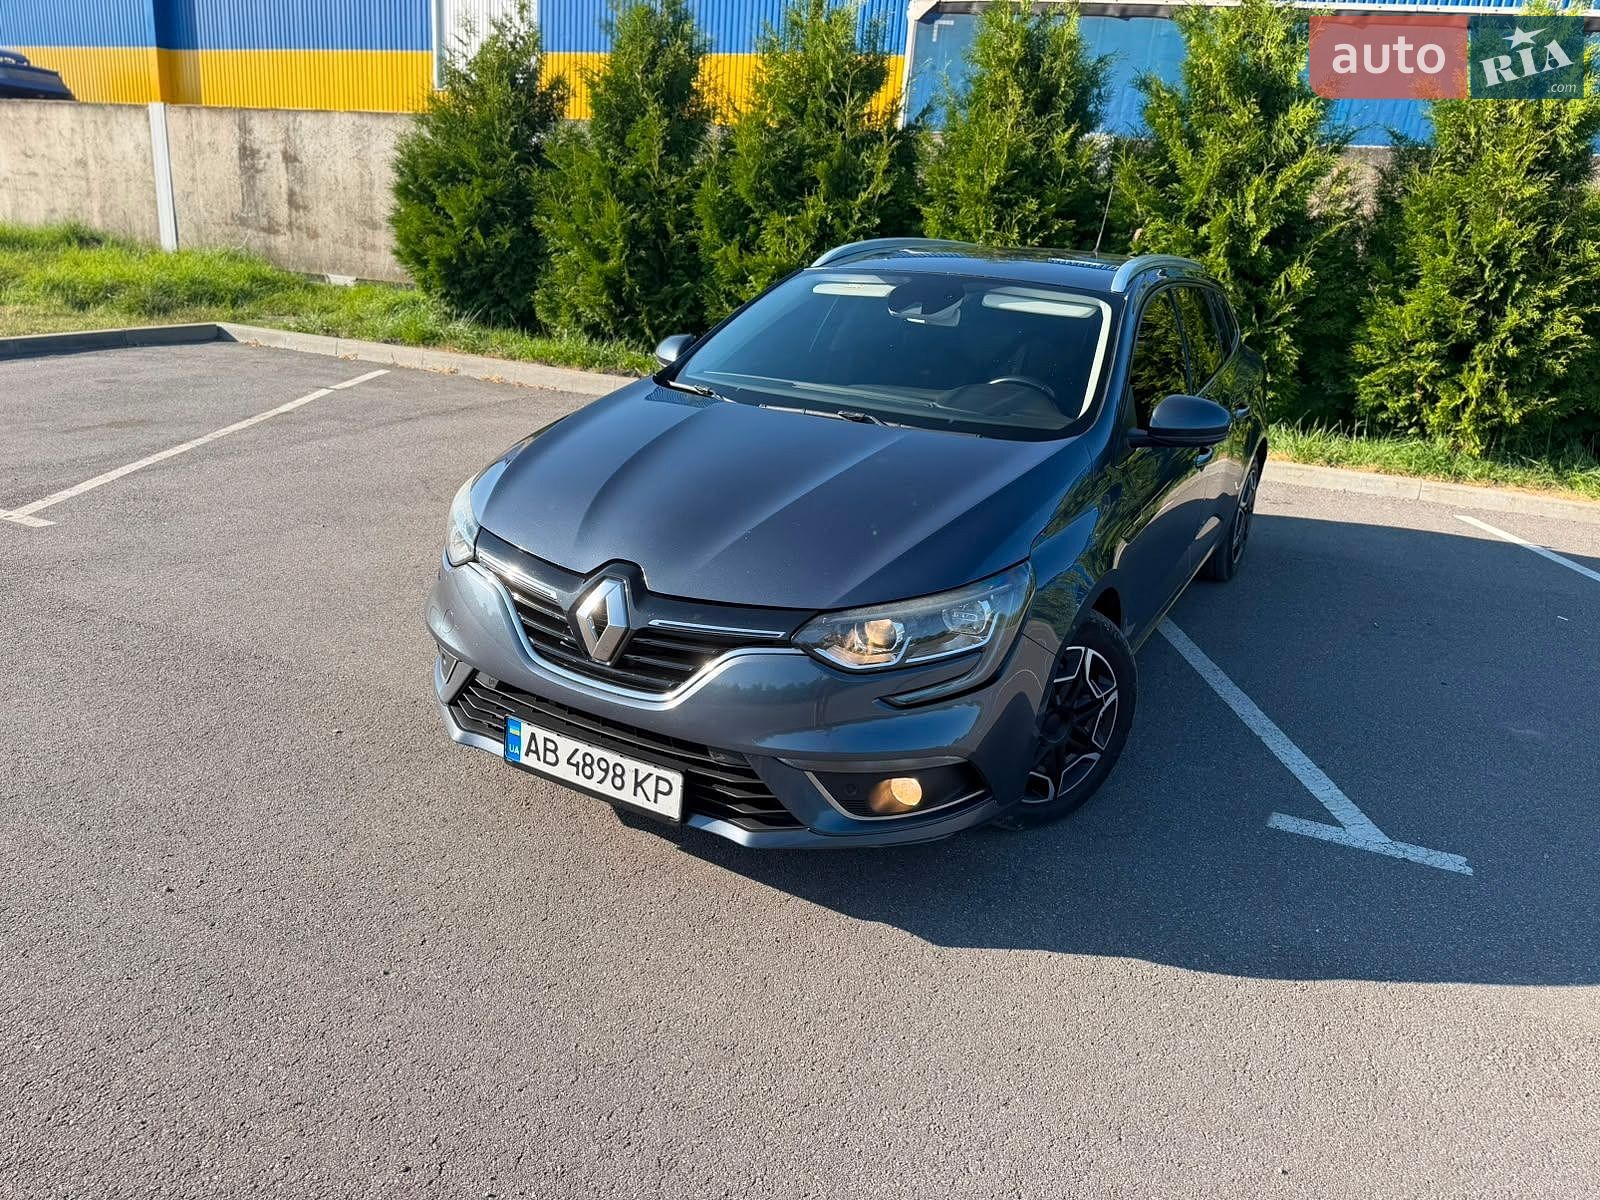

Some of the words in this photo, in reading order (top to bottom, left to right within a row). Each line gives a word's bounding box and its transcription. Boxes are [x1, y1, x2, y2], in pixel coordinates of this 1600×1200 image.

[509, 743, 520, 755] UA
[524, 732, 560, 767] AB
[566, 748, 626, 791] 4898
[633, 768, 673, 804] KP
